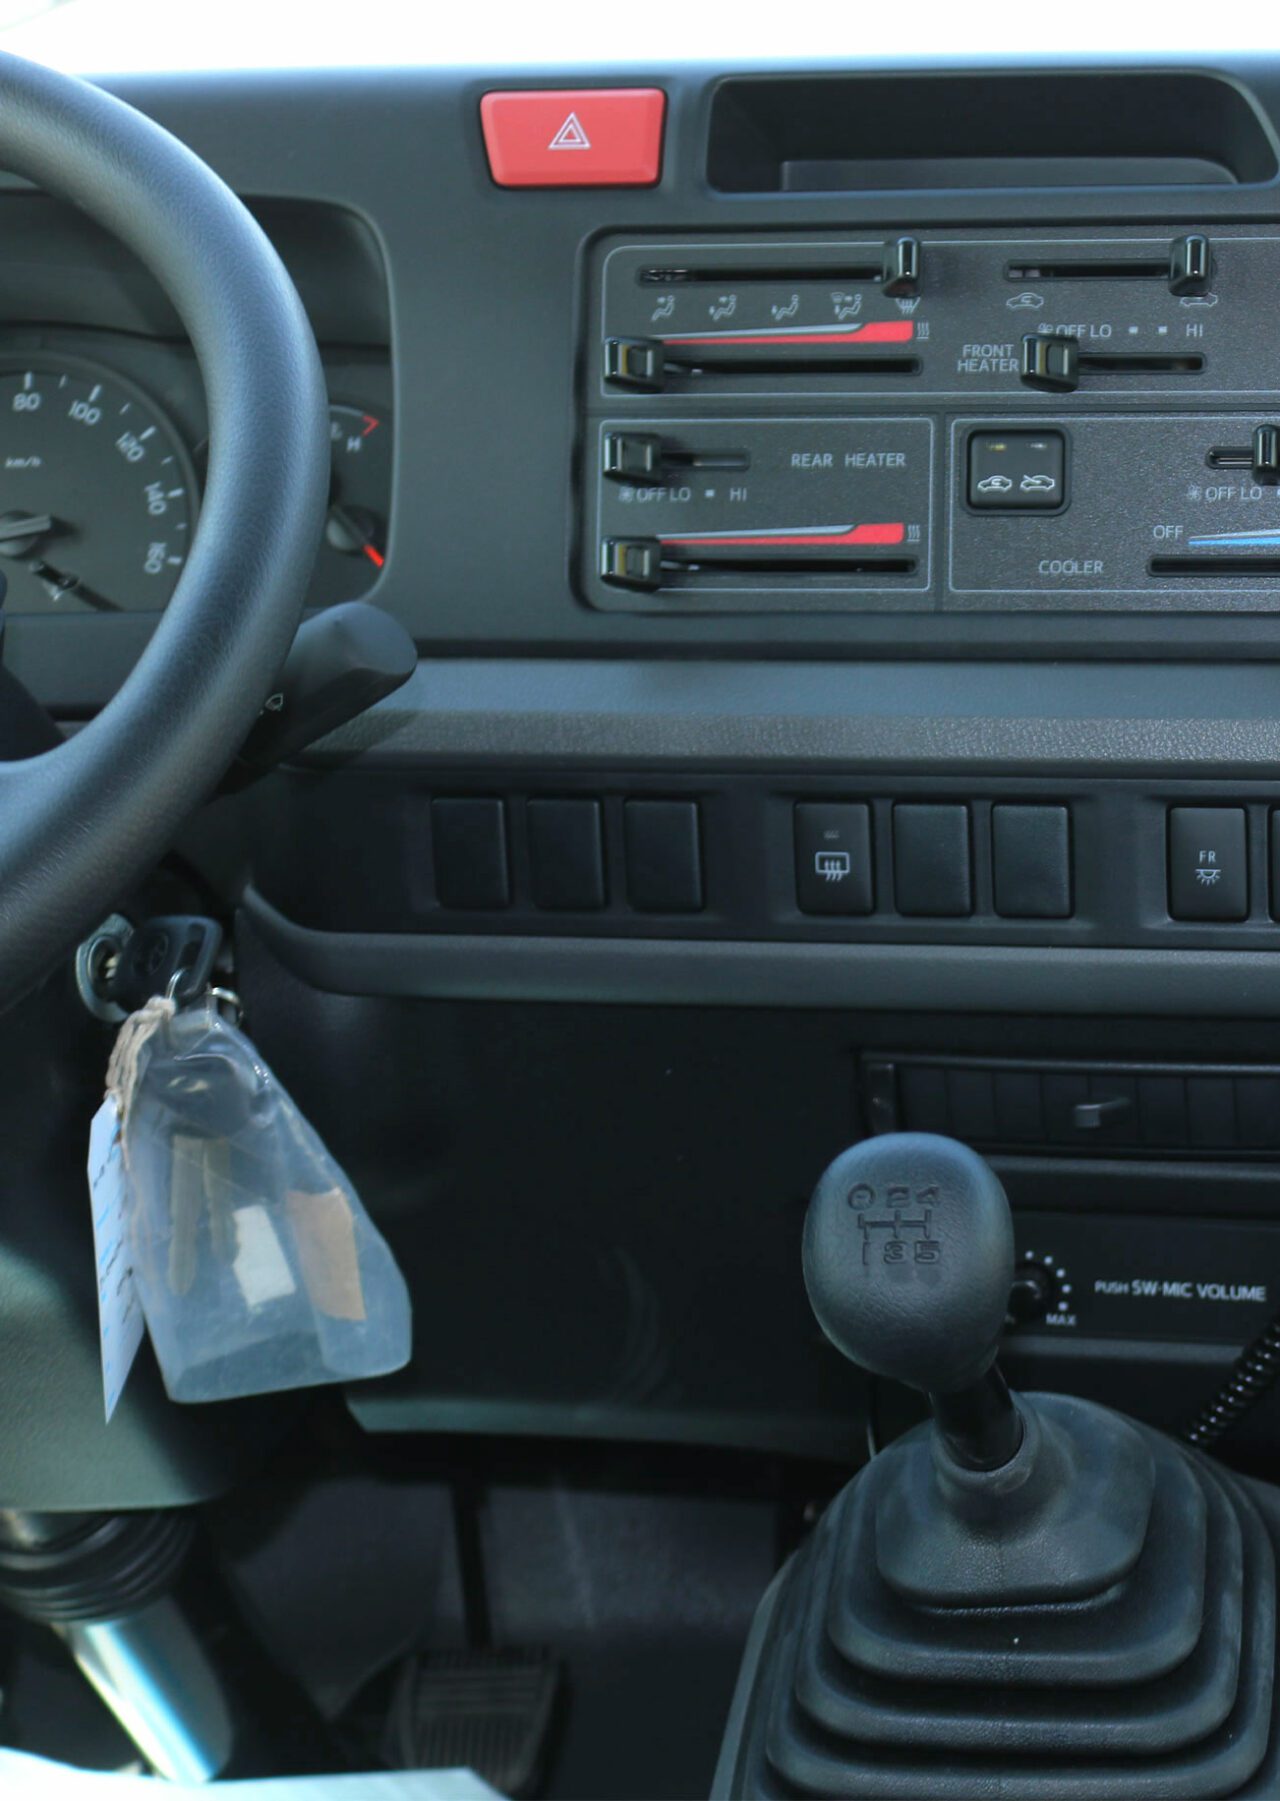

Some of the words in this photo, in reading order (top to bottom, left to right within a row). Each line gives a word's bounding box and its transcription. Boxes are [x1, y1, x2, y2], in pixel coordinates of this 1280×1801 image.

[1056, 324, 1087, 338] OFF
[1090, 323, 1113, 338] LO
[1186, 323, 1204, 338] HI
[962, 344, 1014, 358] FRONT
[957, 359, 1019, 373] HEATER
[13, 392, 41, 411] 80
[68, 401, 101, 425] 100
[115, 432, 144, 462] 120
[5, 456, 42, 468] km/h
[791, 453, 833, 467] REAR
[844, 453, 906, 467] HEATER
[636, 487, 667, 502] OFF
[669, 486, 692, 502] LO
[730, 487, 748, 502] HI
[1205, 486, 1236, 501] OFF
[1240, 486, 1263, 500] LO
[1153, 525, 1184, 540] OFF
[1038, 559, 1104, 574] COOLER
[1199, 850, 1216, 863] FR
[883, 1240, 908, 1265] 3
[914, 1240, 940, 1265] 5
[1095, 1280, 1129, 1294] PUSH
[1197, 1283, 1267, 1301] VOLUME
[1046, 1314, 1077, 1326] MAX
